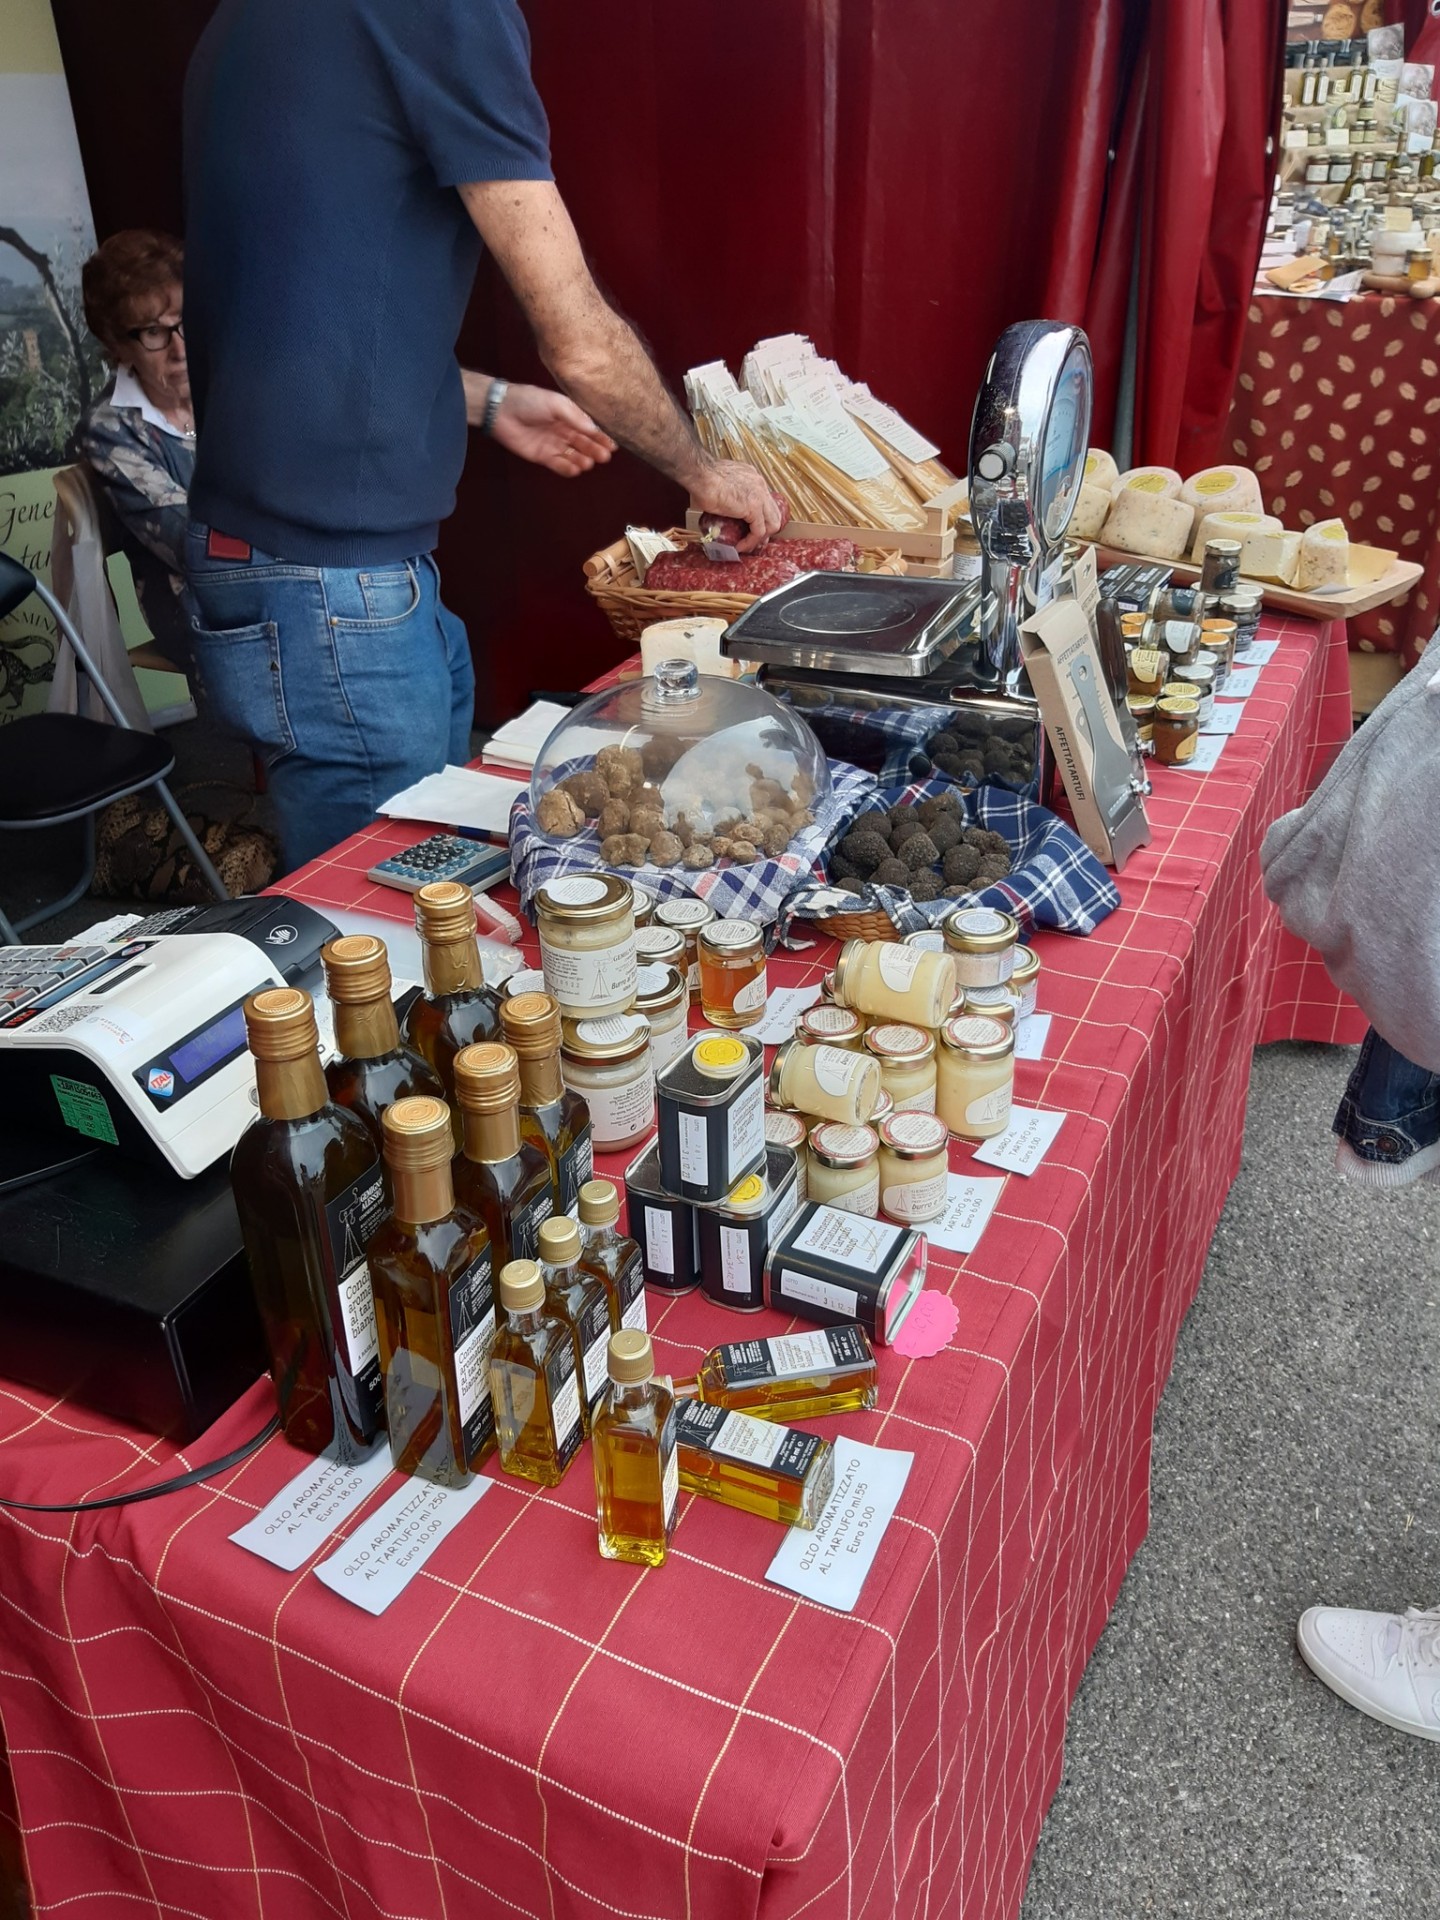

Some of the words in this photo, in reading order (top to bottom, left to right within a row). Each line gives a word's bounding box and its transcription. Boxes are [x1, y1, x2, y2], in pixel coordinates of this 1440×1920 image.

[0, 492, 55, 546] Gene
[20, 542, 51, 571] tar
[1054, 726, 1086, 801] AFFETTATARTUFI
[151, 1072, 172, 1088] ITAL
[993, 1138, 1013, 1157] BURRO
[1008, 1130, 1018, 1142] AL
[1008, 1131, 1031, 1156] TARTUFO
[1019, 1151, 1033, 1164] Euro
[912, 1200, 932, 1211] burro
[932, 1202, 950, 1226] BURRO
[947, 1195, 956, 1208] AL
[944, 1202, 964, 1232] TARTUFO
[961, 1214, 975, 1229] Euro
[805, 1212, 835, 1247] Condimento
[350, 1312, 359, 1326] al
[358, 1302, 372, 1318] tar
[459, 1317, 494, 1364] Condimento
[462, 1369, 481, 1396] bianco
[718, 1415, 742, 1449] Condimento
[265, 1506, 292, 1536] OLIO
[294, 1454, 345, 1513] AROMATIZ
[287, 1519, 303, 1535] AL
[302, 1475, 346, 1520] TARTUFO
[316, 1501, 340, 1523] Euro
[339, 1476, 364, 1501] 18,00
[343, 1551, 371, 1577] OLIO
[370, 1479, 440, 1550] AROMATIZZAT
[800, 1542, 820, 1571] OLIO
[819, 1459, 861, 1543] AROMATIZZATO
[846, 1530, 865, 1554] Euro
[862, 1506, 876, 1530] 5,00
[364, 1564, 378, 1581] AL
[377, 1520, 421, 1567] TARTUFO
[419, 1510, 432, 1524] ml
[430, 1491, 449, 1510] 250
[396, 1549, 421, 1568] Euro
[416, 1519, 443, 1547] 10,00
[818, 1558, 832, 1575] AL
[825, 1508, 855, 1558] TARTUFO
